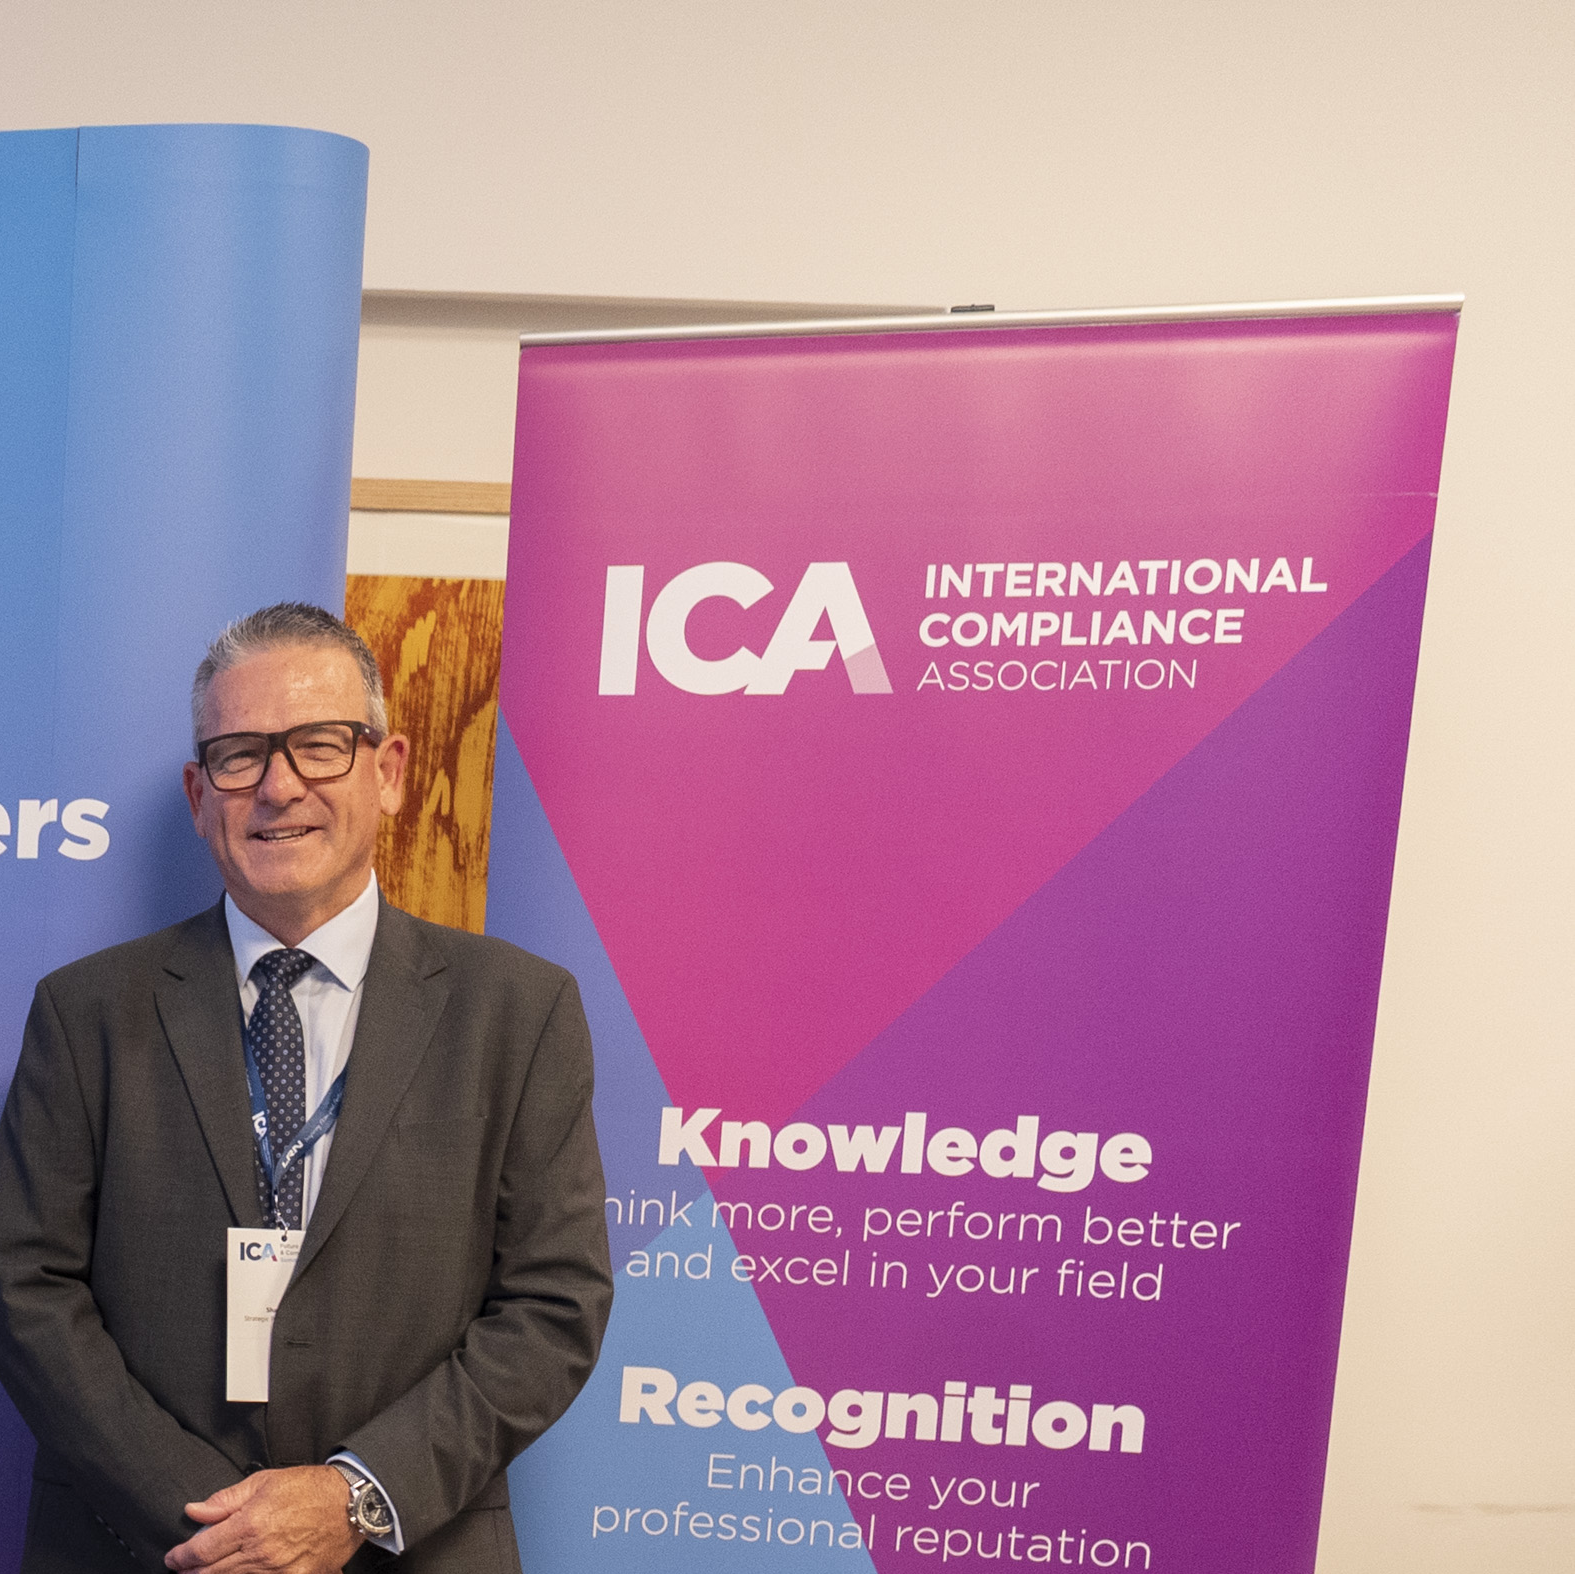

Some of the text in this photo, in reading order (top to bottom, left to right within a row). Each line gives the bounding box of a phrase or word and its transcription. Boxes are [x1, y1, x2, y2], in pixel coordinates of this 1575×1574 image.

[924, 557, 1328, 599] INTERNATIONAL
[598, 561, 893, 696] ICA
[918, 607, 1244, 648] COMPLIANCE
[916, 658, 1198, 691] ASSOCIATION
[252, 1110, 267, 1140] ICA
[658, 1106, 1153, 1193] Knowledge
[281, 1140, 304, 1168] LRN
[712, 1200, 843, 1237] more,
[862, 1200, 1062, 1243] perform
[1082, 1206, 1241, 1250] better
[240, 1242, 278, 1262] ICA
[625, 1244, 1164, 1302] and excel in your field
[618, 1365, 1146, 1453] Recognition
[706, 1453, 1040, 1510] Enhance your
[592, 1501, 1153, 1570] professional reputation
